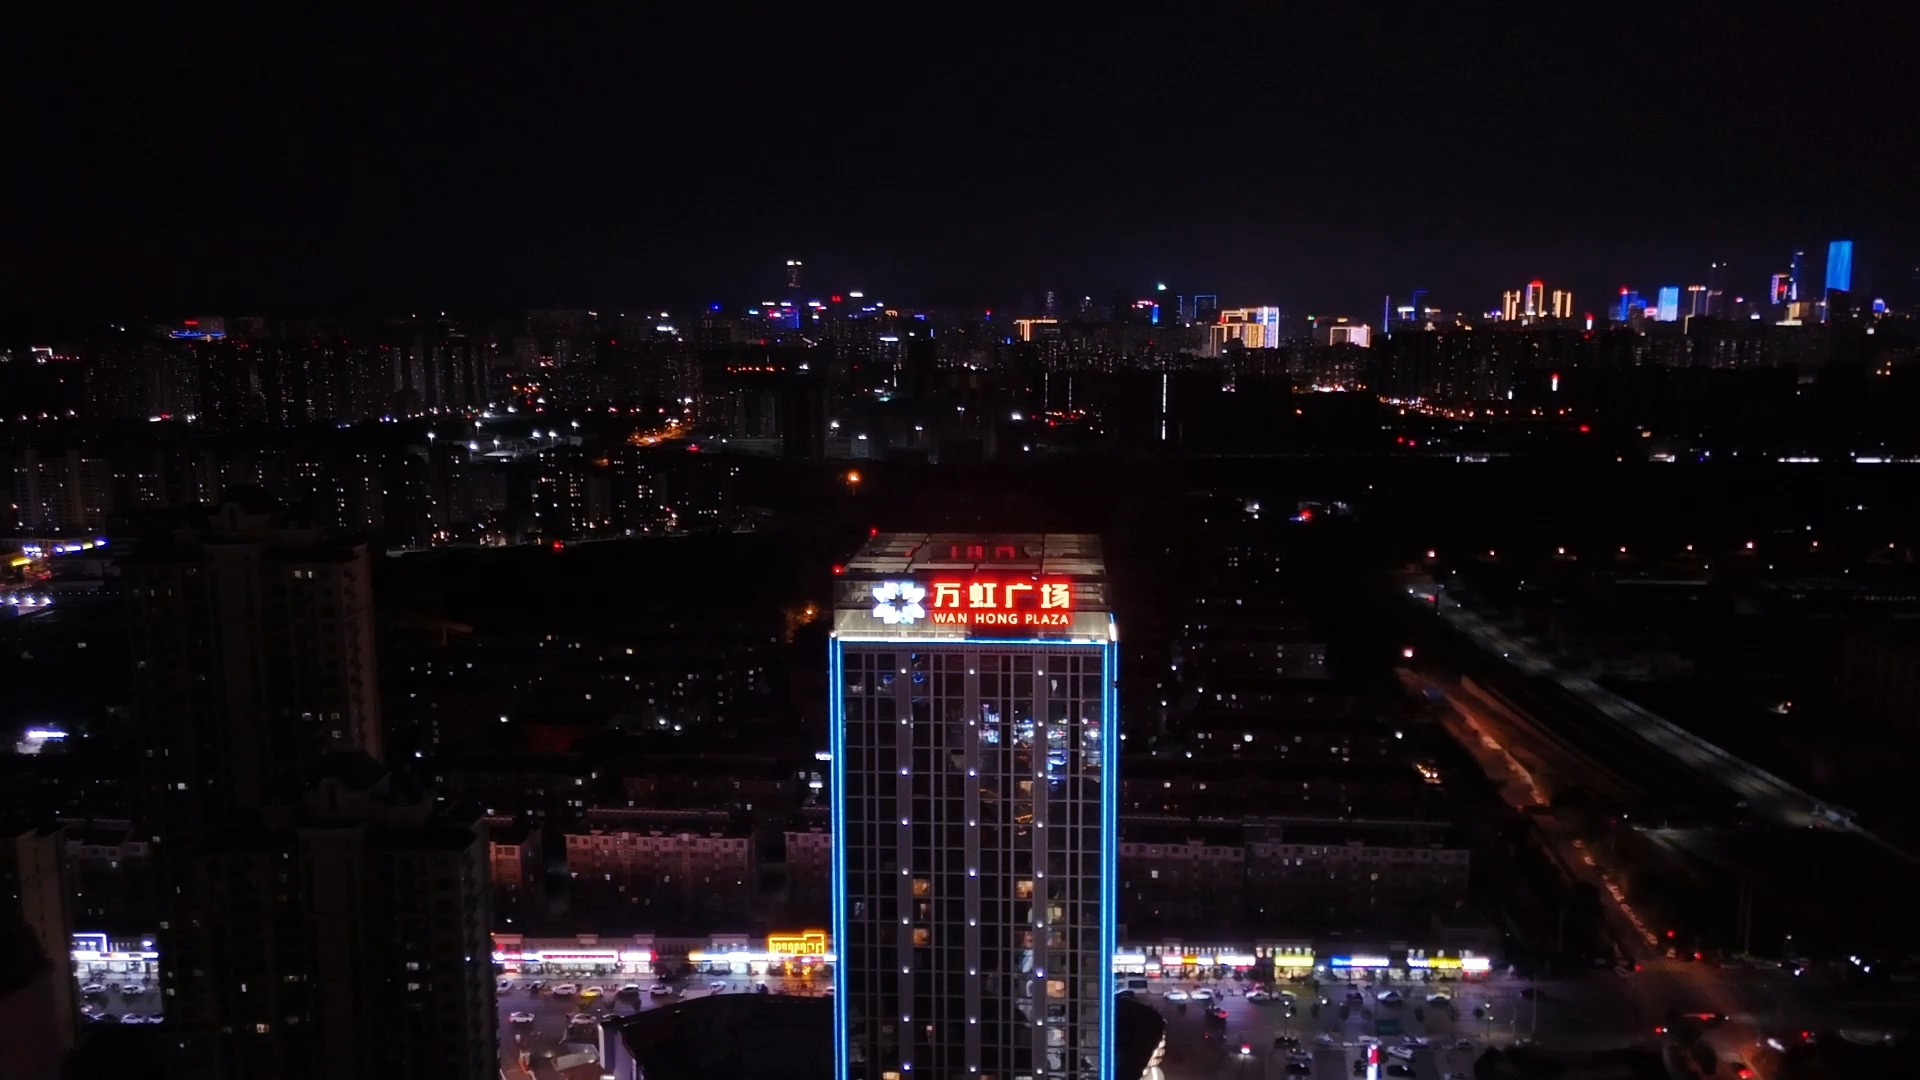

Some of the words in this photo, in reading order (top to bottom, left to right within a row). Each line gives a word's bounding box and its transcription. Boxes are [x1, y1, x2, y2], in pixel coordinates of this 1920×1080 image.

[933, 582, 1070, 609] 万虹广场
[933, 613, 968, 625] WAN
[975, 613, 1018, 625] HONG
[1025, 613, 1069, 625] PLAZA
